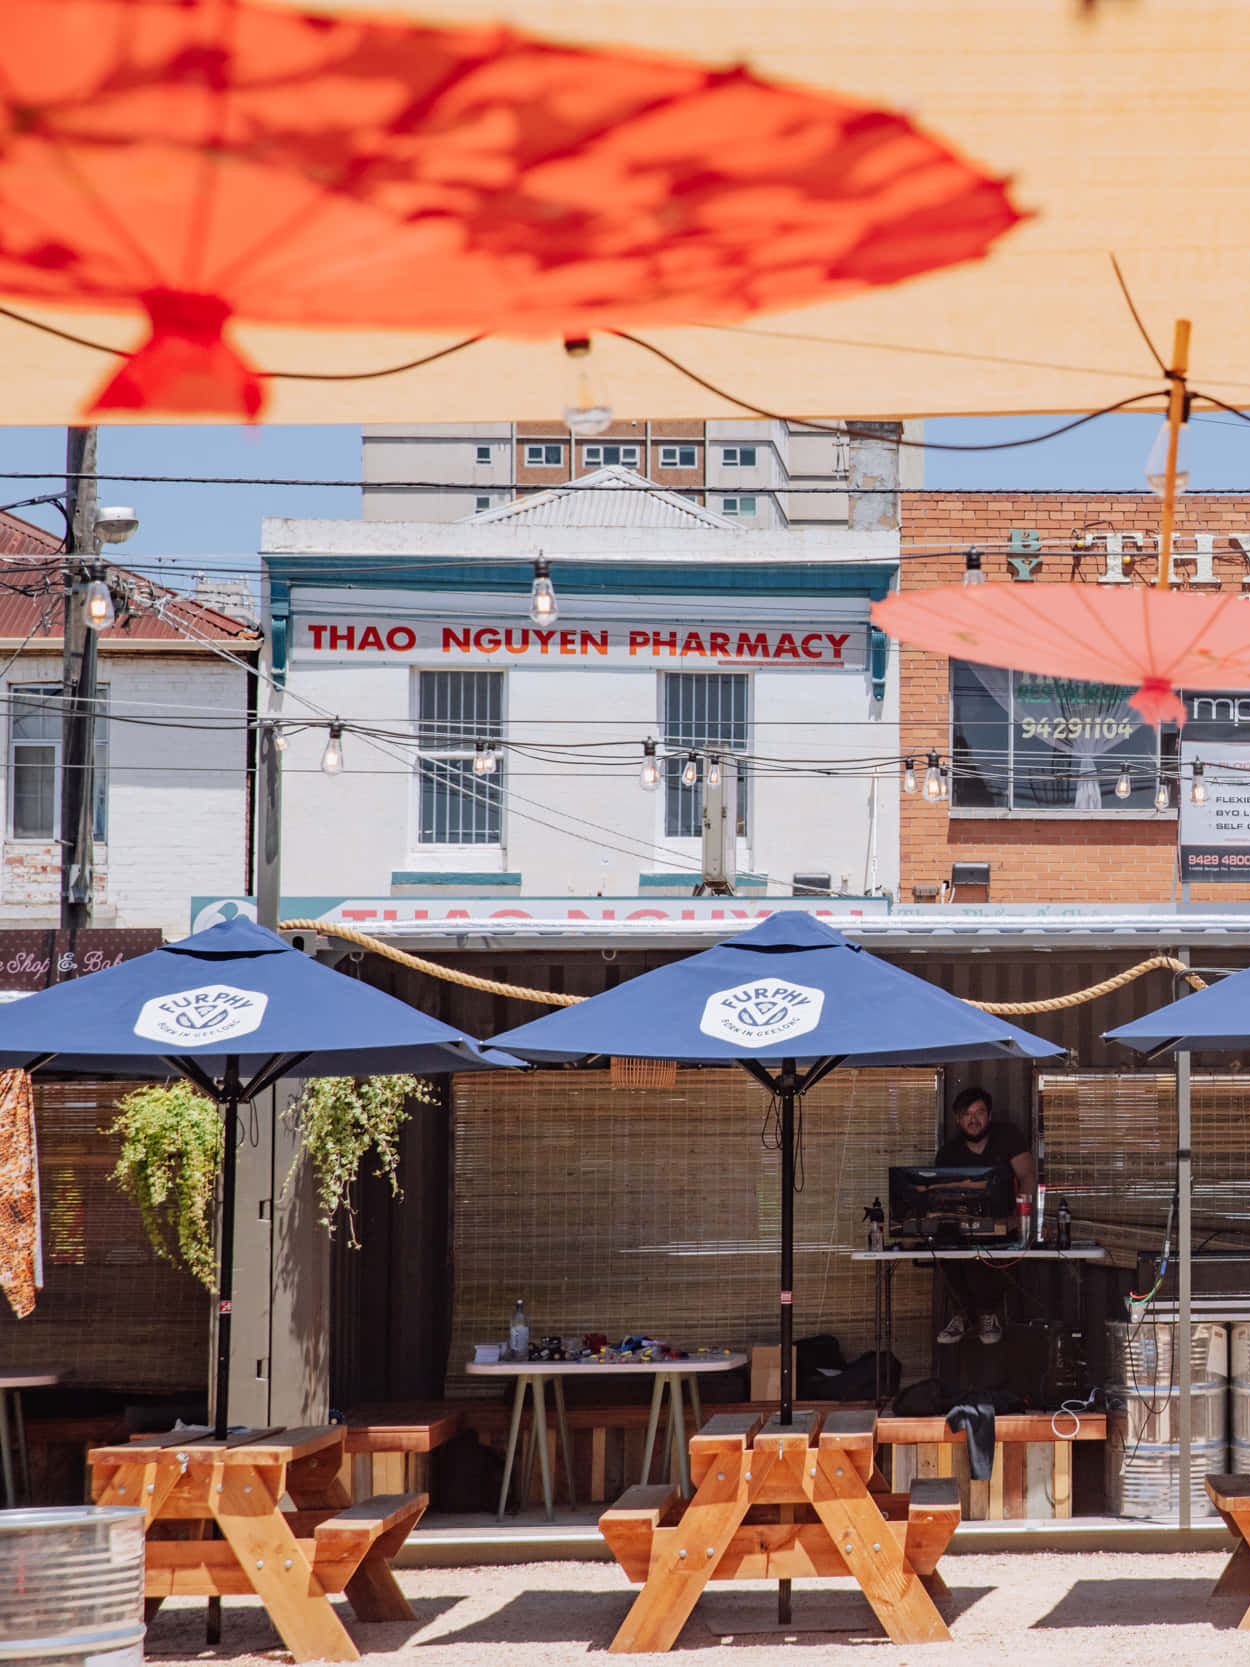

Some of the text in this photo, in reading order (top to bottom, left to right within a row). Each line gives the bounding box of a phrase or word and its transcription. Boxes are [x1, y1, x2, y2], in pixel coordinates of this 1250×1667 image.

[307, 624, 851, 659] THAO NGUYEN PHARMACY
[1021, 716, 1133, 739] 94291104
[1216, 809, 1240, 817] BYO
[1188, 855, 1219, 865] 9429
[6, 951, 51, 980] Shop
[158, 992, 254, 1013] FURPHY
[719, 987, 812, 1009] FURPHY
